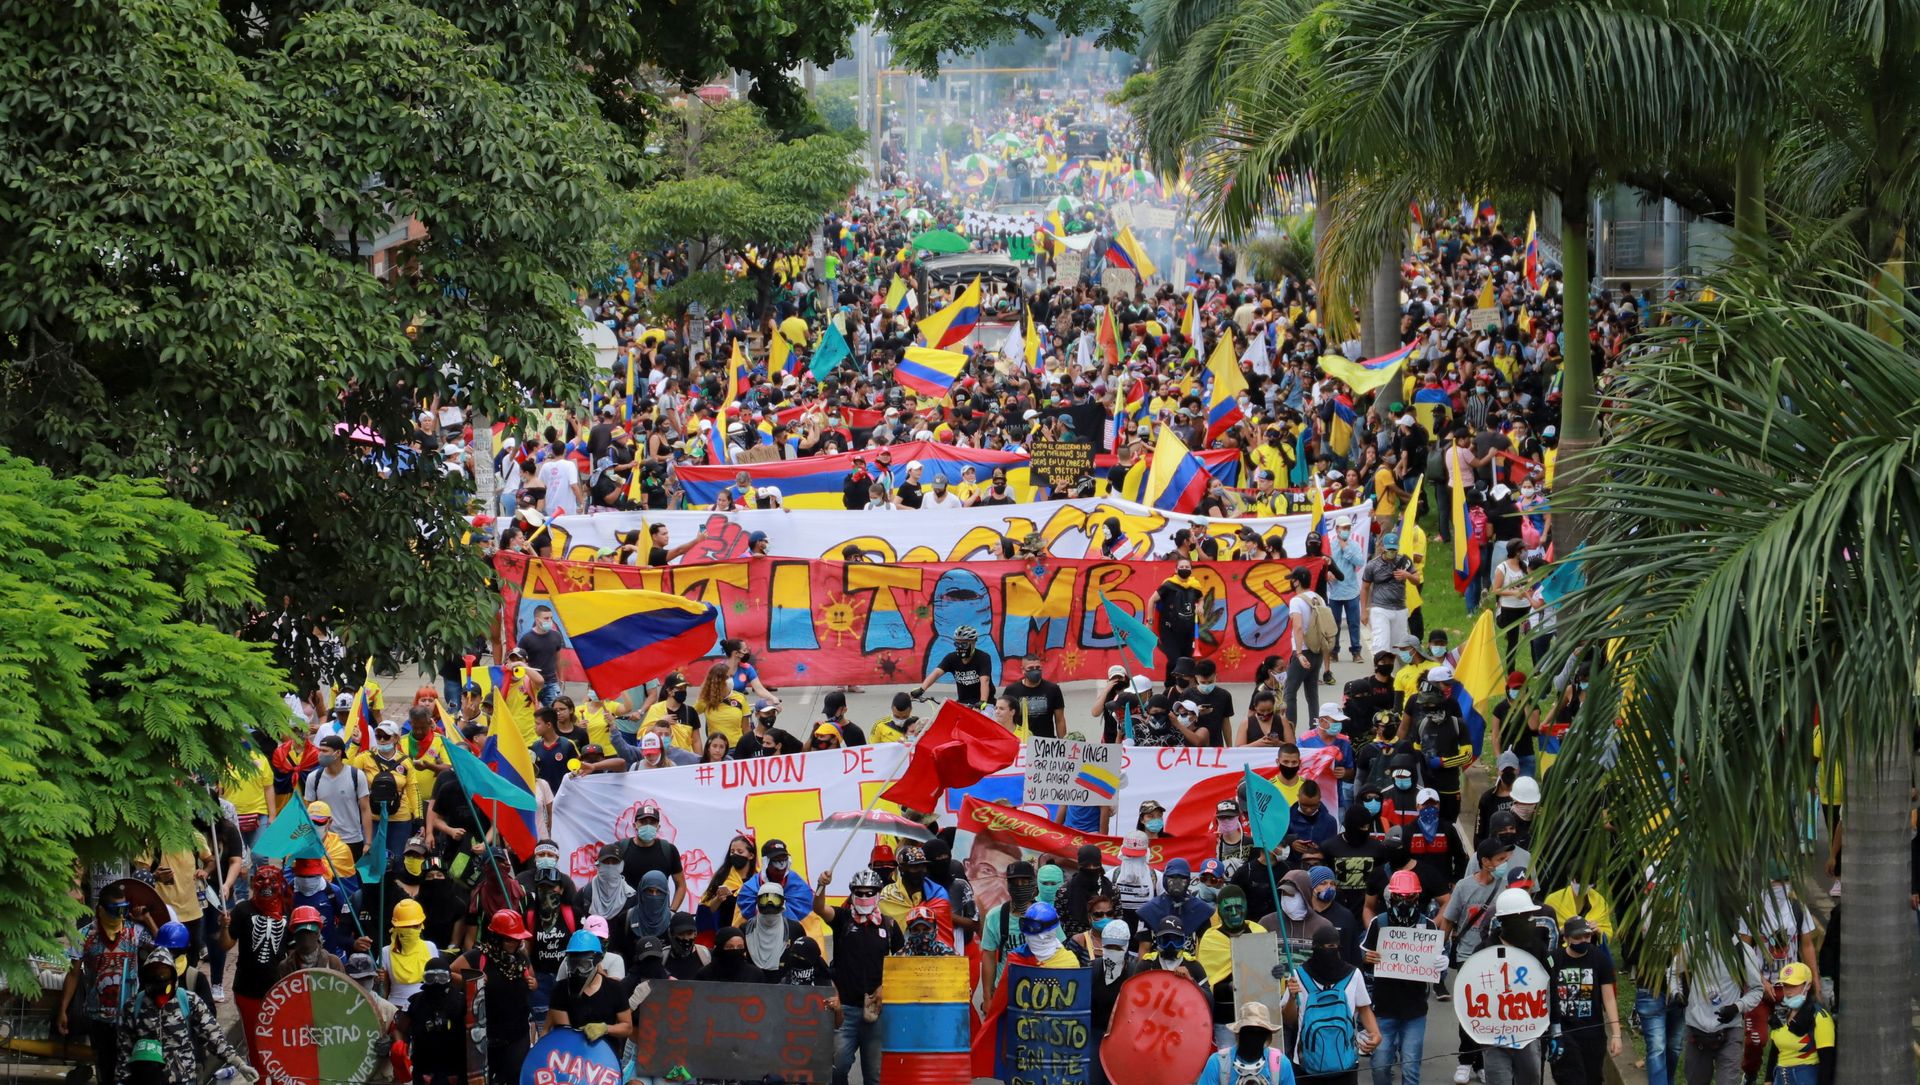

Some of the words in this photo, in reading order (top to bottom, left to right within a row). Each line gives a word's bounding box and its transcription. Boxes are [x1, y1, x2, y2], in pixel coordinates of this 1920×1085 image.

[1055, 467, 1079, 475] METEN
[843, 747, 874, 774] DE
[1157, 747, 1228, 770] CALI
[1050, 761, 1057, 771] LA
[1033, 773, 1041, 783] EL
[1015, 978, 1077, 1011] CON
[282, 1024, 361, 1047] LIBERTAD
